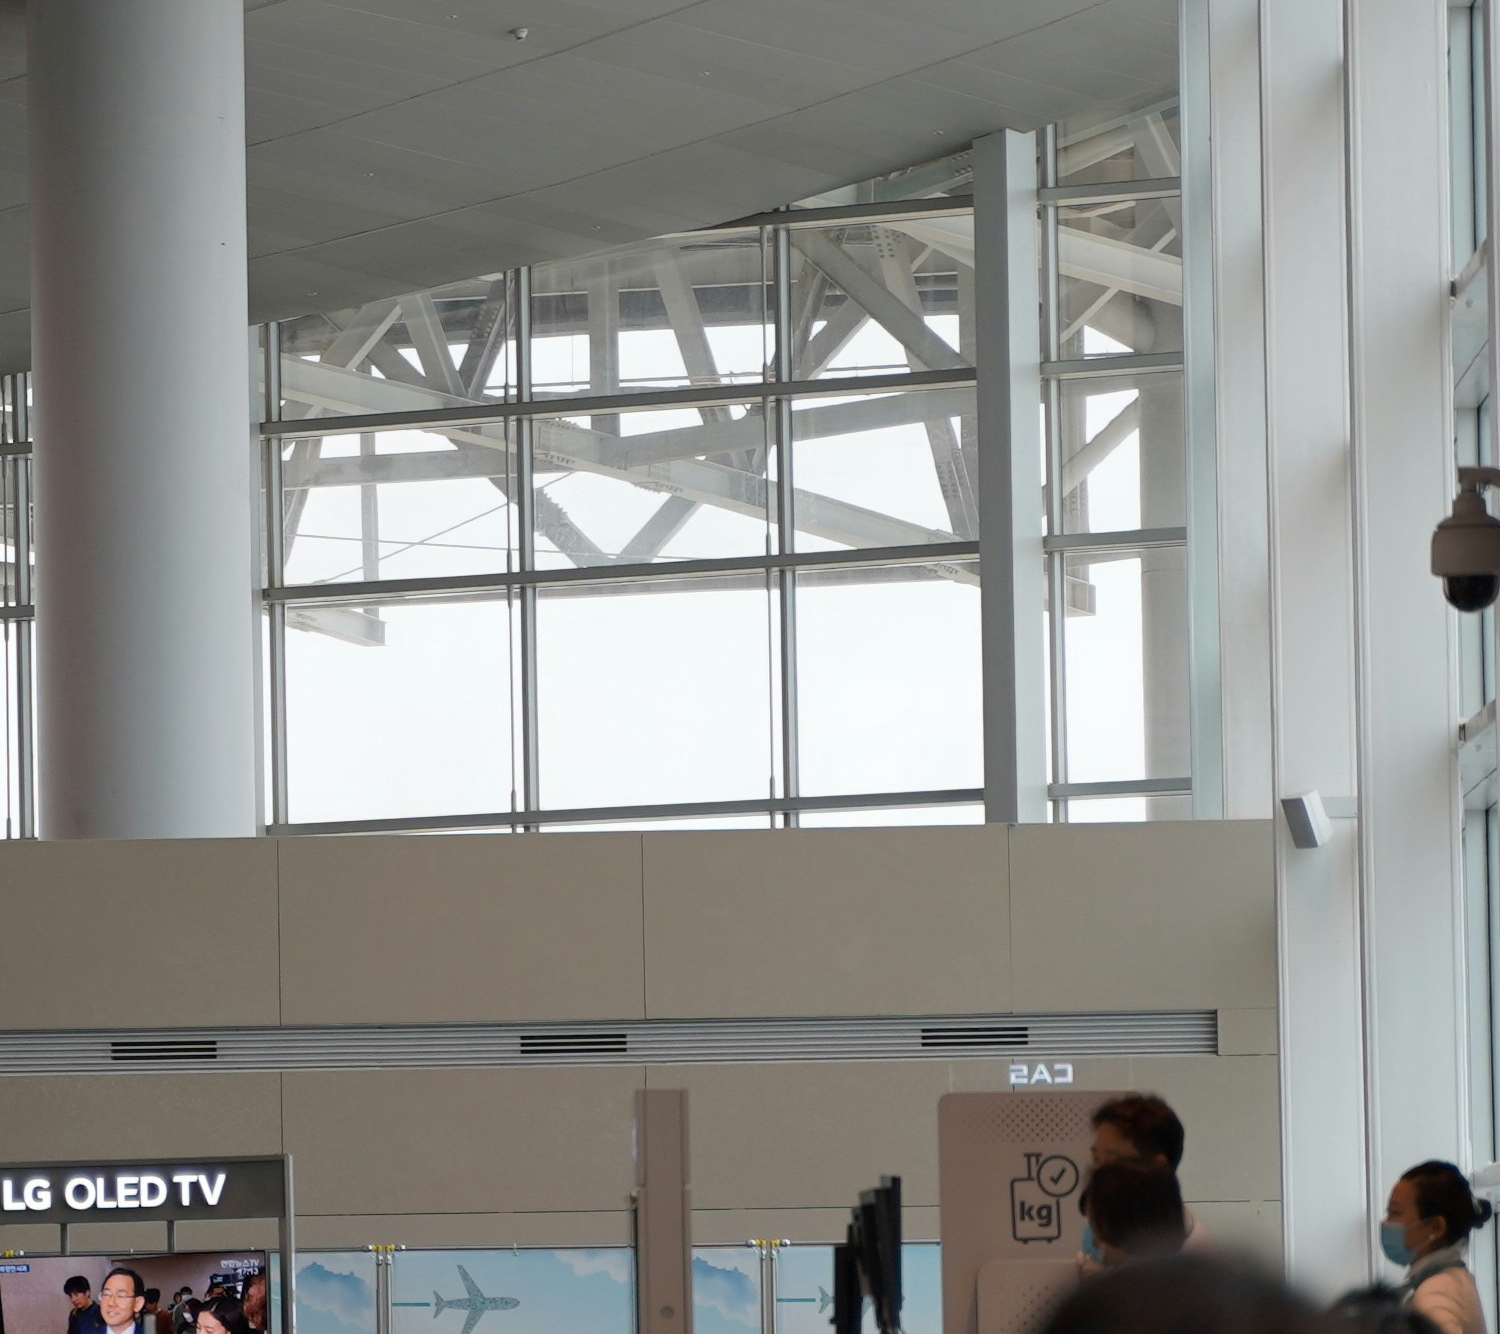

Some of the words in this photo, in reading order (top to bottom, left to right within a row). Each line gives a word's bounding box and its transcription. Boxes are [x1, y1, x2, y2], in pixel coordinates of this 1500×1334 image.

[2, 1178, 52, 1211] LG
[64, 1174, 168, 1210] OLED
[173, 1173, 226, 1206] TV
[1019, 1200, 1052, 1227] kg
